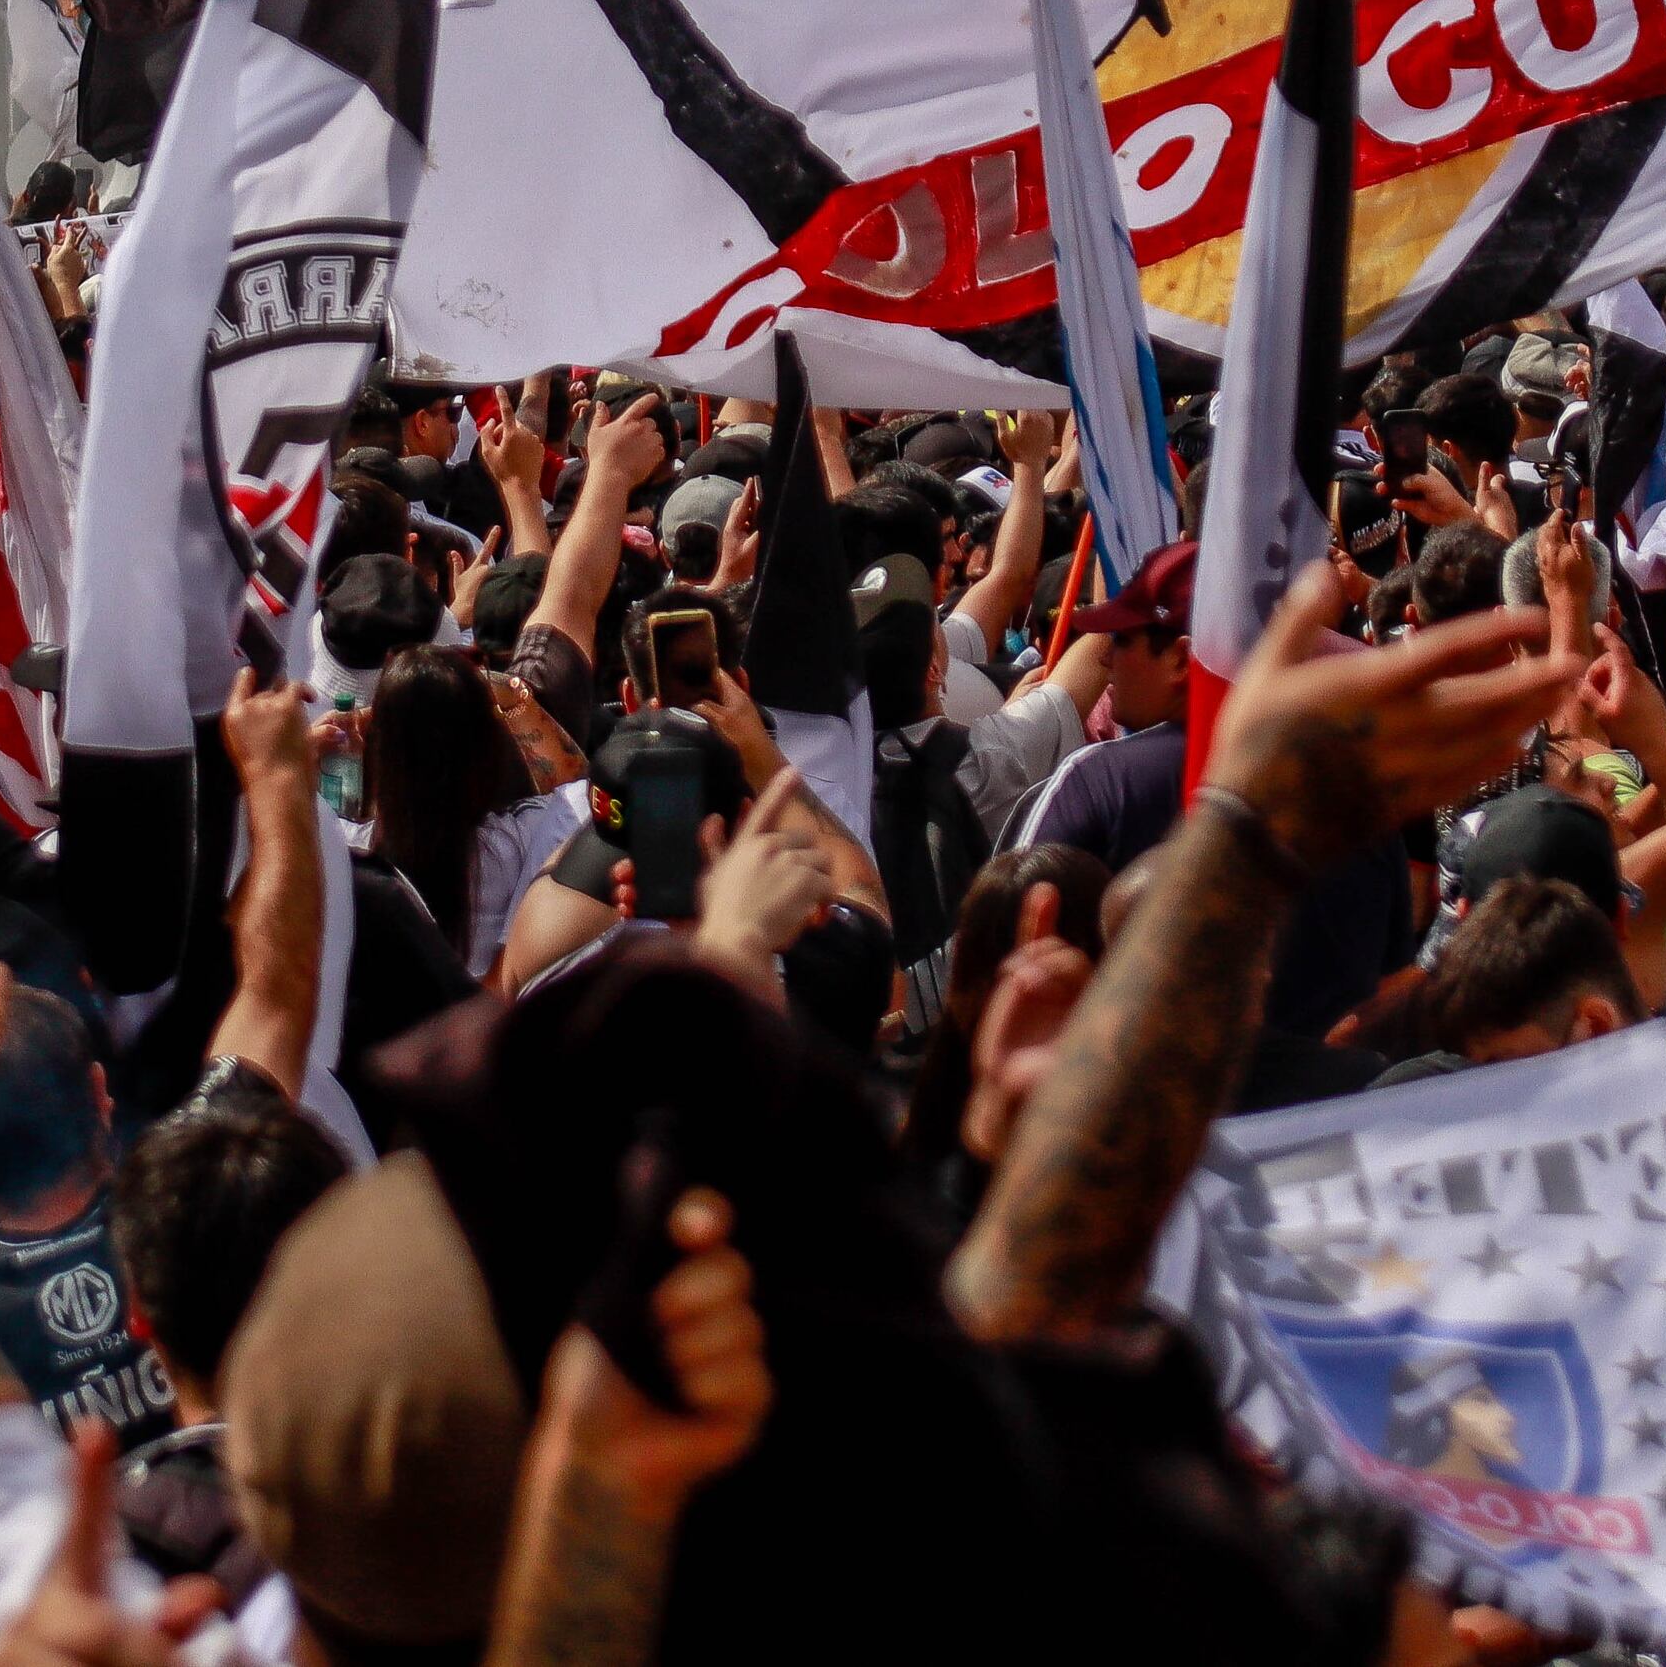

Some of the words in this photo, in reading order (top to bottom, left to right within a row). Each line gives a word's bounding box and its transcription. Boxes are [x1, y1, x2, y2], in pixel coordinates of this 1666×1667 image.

[47, 1269, 110, 1333] MG
[56, 1342, 94, 1366] Since
[98, 1330, 130, 1351] 1924
